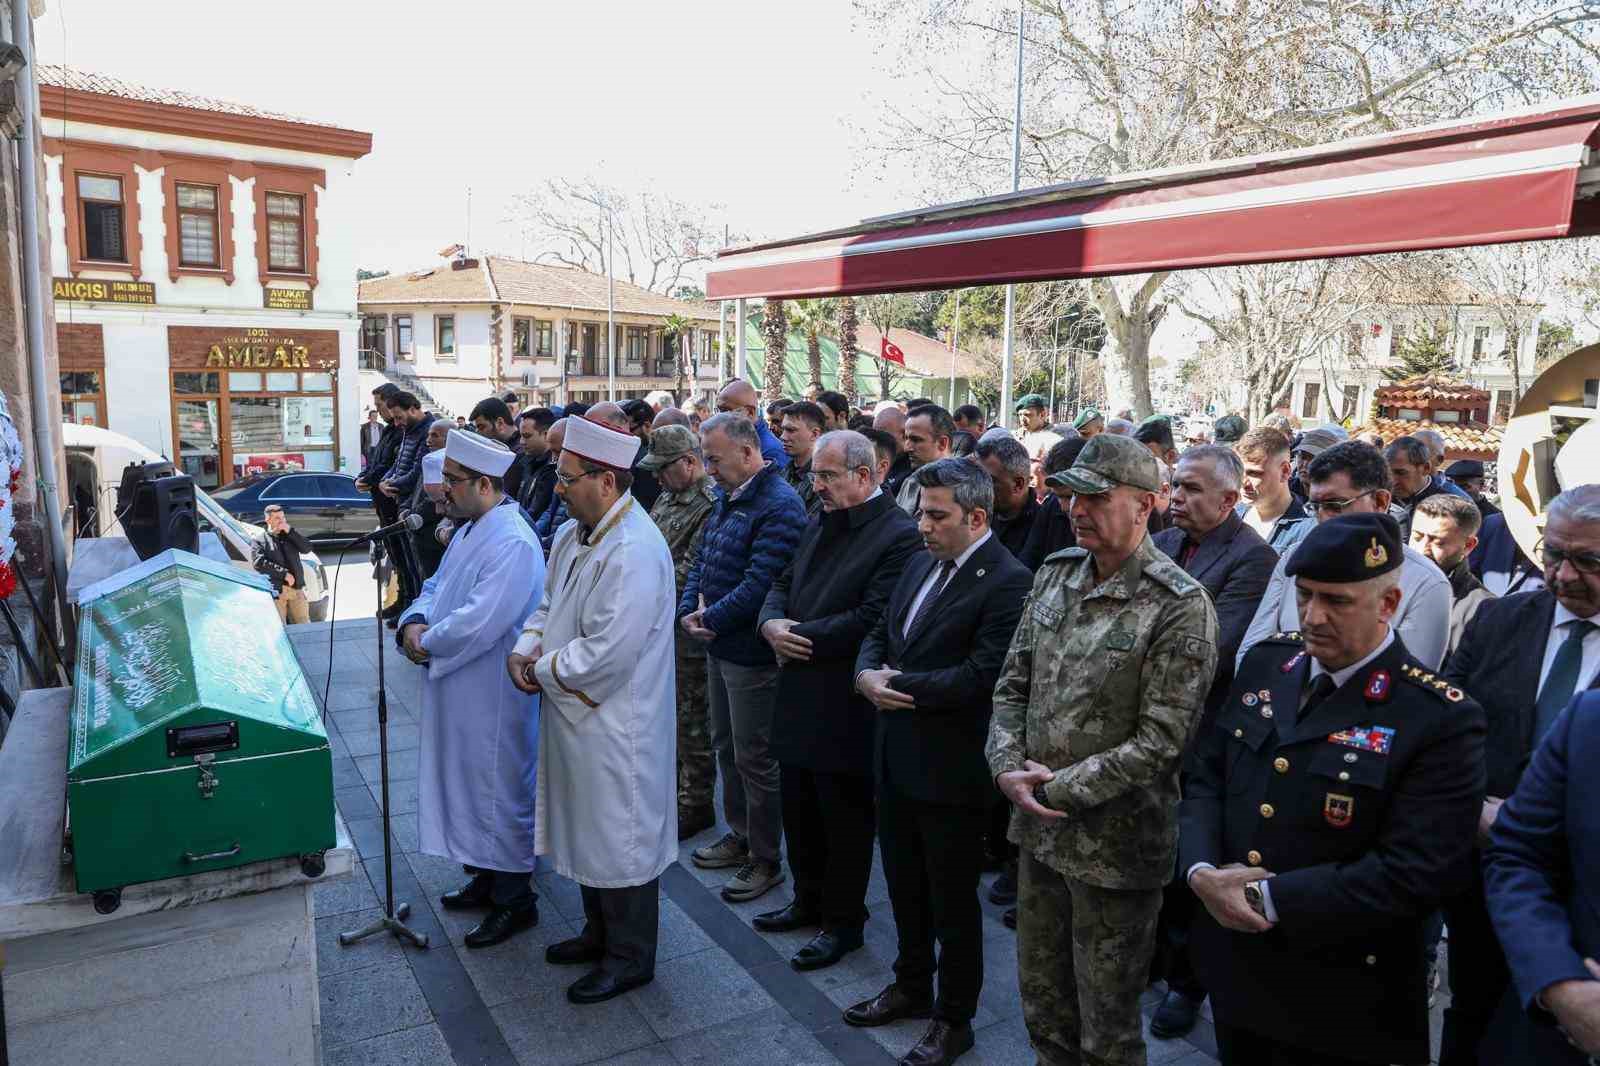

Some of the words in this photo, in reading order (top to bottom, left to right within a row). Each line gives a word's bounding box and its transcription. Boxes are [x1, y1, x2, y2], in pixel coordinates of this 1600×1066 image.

[271, 289, 305, 299] AVUKAT
[247, 328, 269, 337] 1001
[206, 343, 311, 369] AMBAR
